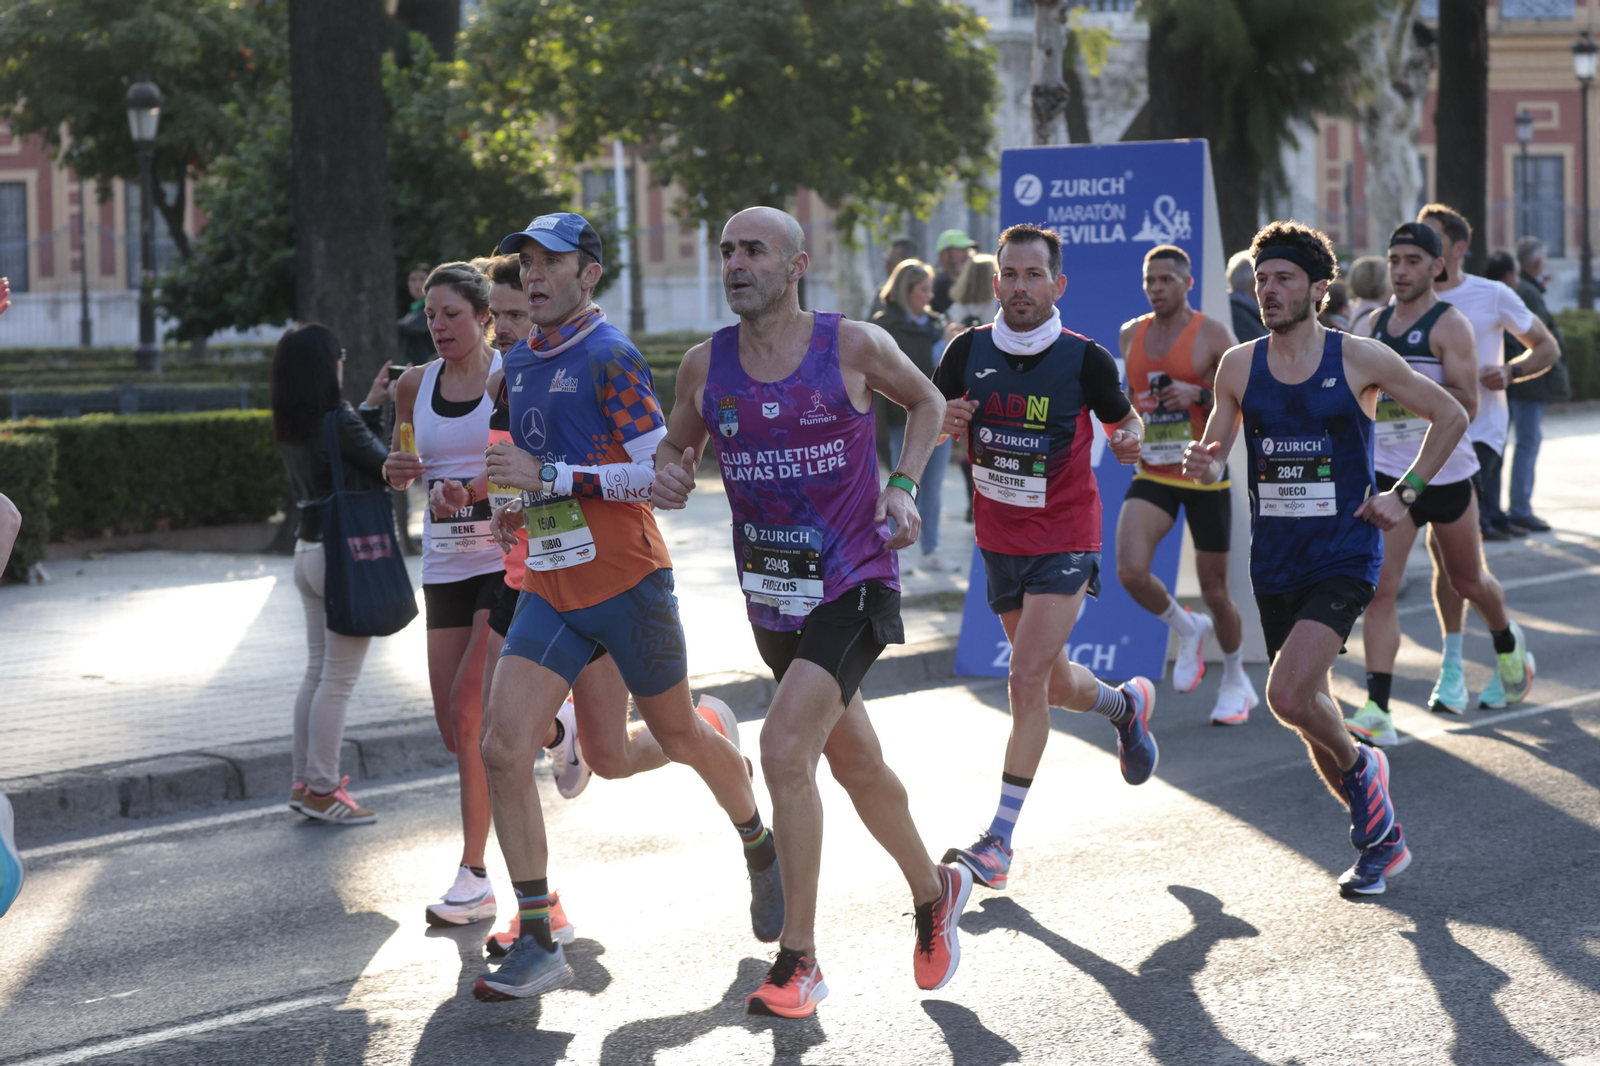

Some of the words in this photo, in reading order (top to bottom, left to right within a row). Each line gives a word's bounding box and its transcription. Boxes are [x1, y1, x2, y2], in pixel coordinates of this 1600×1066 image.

[1050, 177, 1125, 198] ZURICH
[1048, 201, 1126, 223] MARATÓN
[983, 391, 1050, 422] ADN
[800, 414, 838, 426] Runners
[994, 433, 1039, 449] ZURICH
[1276, 440, 1322, 452] ZURICH
[720, 450, 751, 466] CLUB
[756, 438, 846, 465] ATLETISMO
[724, 465, 775, 481] PLAYAS
[779, 463, 802, 479] DE
[807, 452, 847, 476] LEPE
[993, 455, 1020, 471] 2846
[988, 471, 1026, 488] MAESTRE
[1277, 465, 1304, 479] 2847
[1278, 486, 1307, 497] QUECO
[450, 525, 475, 535] IRENE
[537, 515, 556, 531] 1500
[541, 537, 562, 551] RUBIO
[759, 529, 810, 544] ZURICH
[763, 556, 790, 574] 2948
[761, 578, 798, 592] FIDELUS
